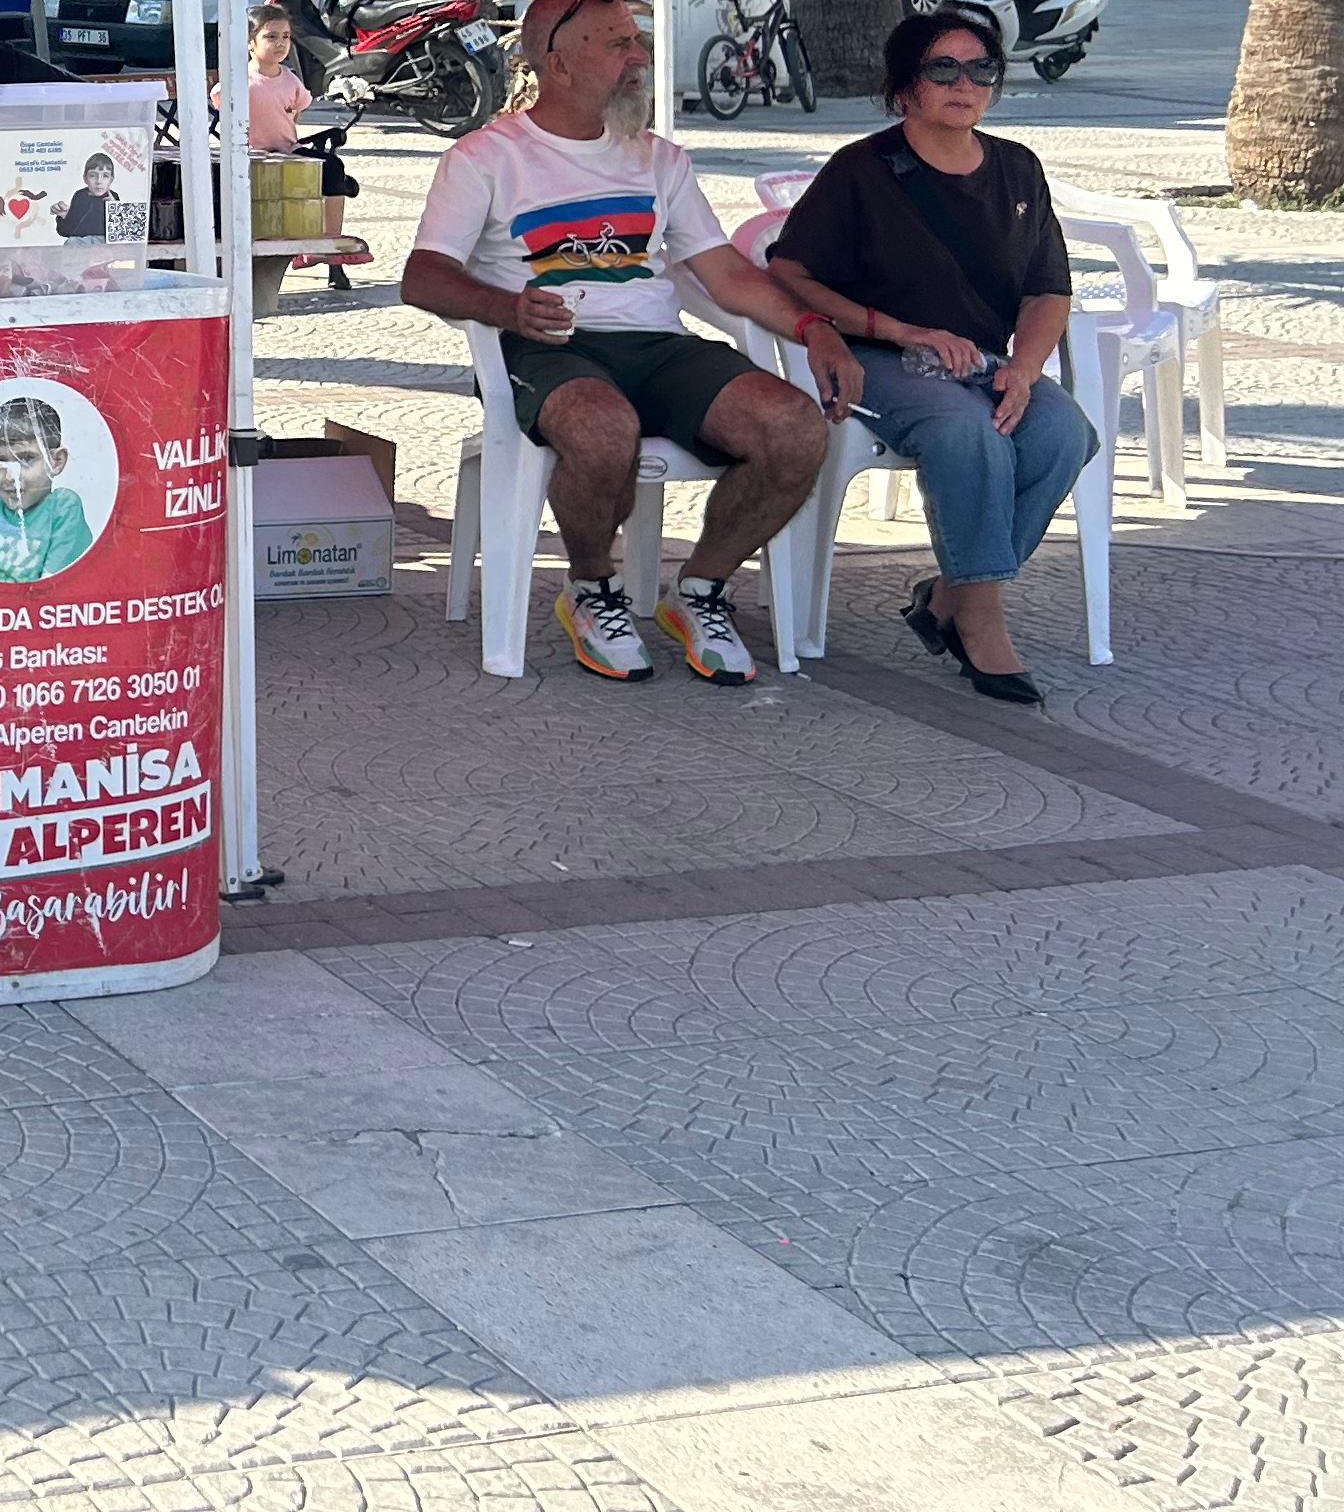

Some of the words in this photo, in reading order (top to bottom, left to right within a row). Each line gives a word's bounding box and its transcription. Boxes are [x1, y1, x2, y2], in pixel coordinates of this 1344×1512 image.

[153, 424, 227, 471] VALİLİK
[165, 471, 222, 518] İZİNLİ
[267, 544, 358, 565] Limonatan
[39, 601, 123, 631] SENDE
[127, 591, 209, 624] DESTEK
[10, 643, 108, 670] Bankası:
[12, 681, 65, 708] 1066
[71, 676, 121, 704] 7126
[127, 670, 179, 698] 3050
[183, 665, 201, 691] 01
[90, 710, 189, 741] Cantekin
[10, 792, 208, 866] ALPEREN
